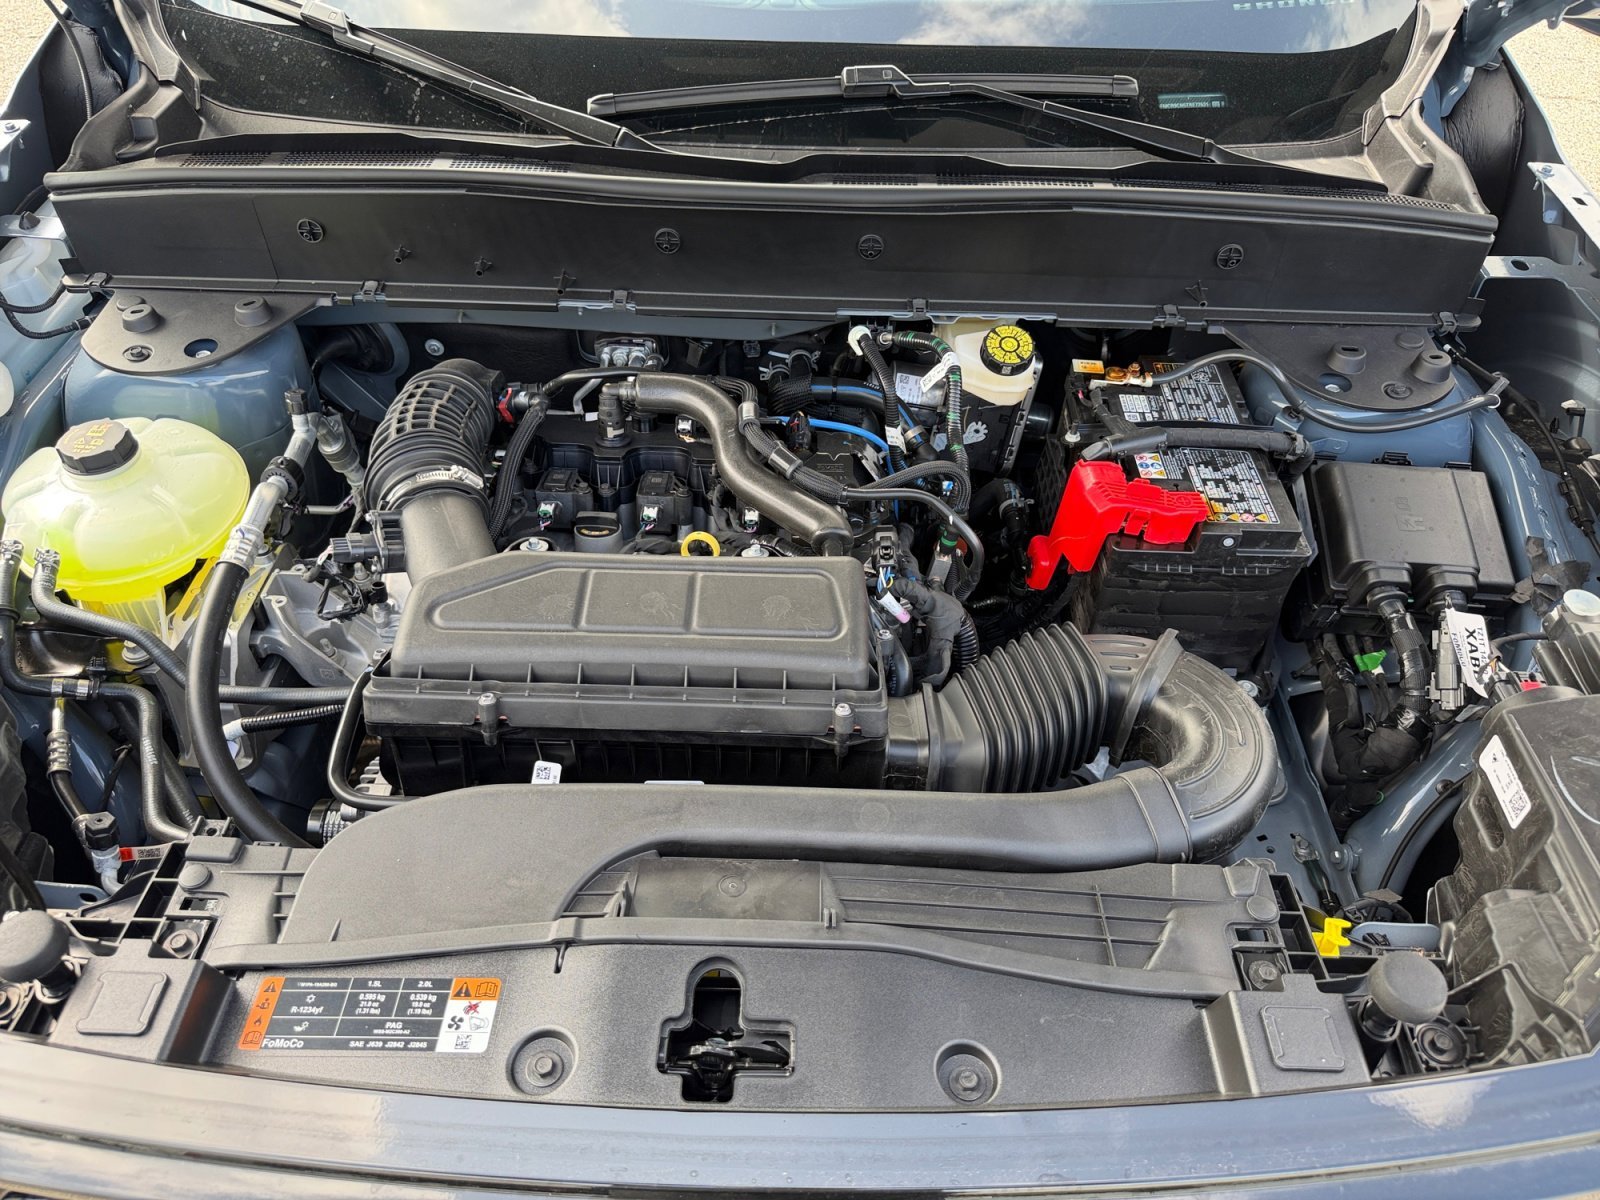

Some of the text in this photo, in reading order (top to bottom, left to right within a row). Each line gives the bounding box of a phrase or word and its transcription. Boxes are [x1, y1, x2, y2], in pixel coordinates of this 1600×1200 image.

[367, 980, 382, 988] 1.5L
[417, 980, 433, 988] 2.0L
[378, 993, 386, 1002] kg
[428, 993, 437, 1002] kg
[290, 1006, 324, 1015] R-1234yf
[385, 1021, 403, 1029] PAG
[262, 1038, 304, 1048] FoMoCo
[366, 1040, 383, 1048] J639
